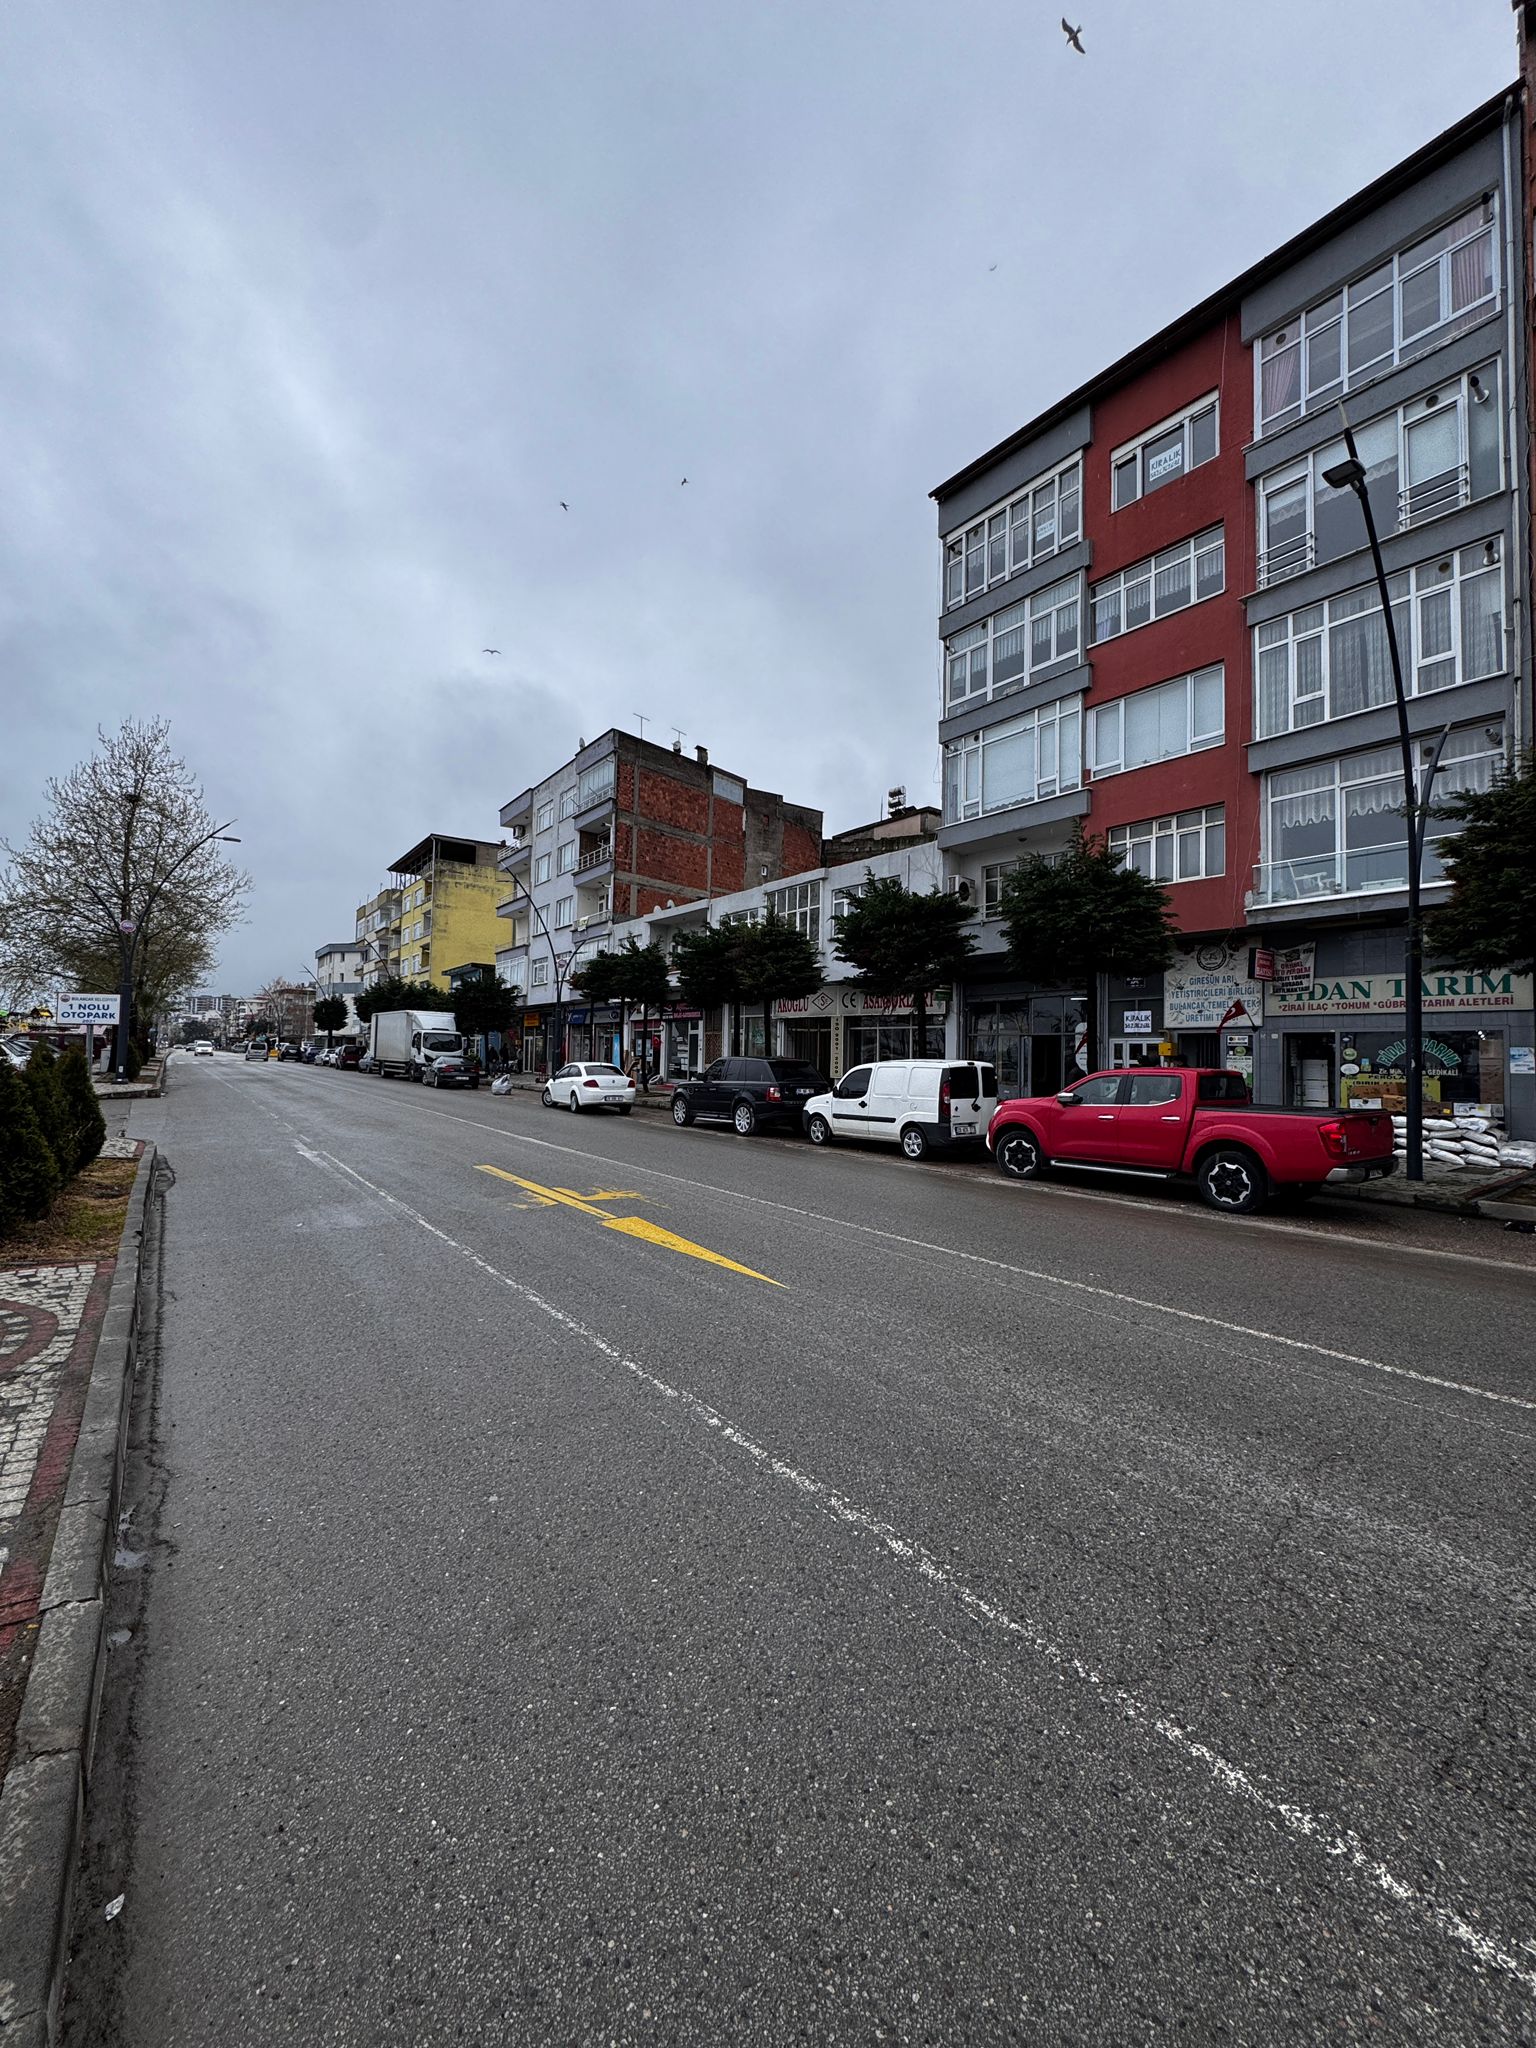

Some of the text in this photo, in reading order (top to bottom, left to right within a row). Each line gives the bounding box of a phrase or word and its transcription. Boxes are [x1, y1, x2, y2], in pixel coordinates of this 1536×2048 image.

[1279, 980, 1374, 1003] DAN
[78, 1003, 110, 1011] NOLU
[841, 992, 857, 1009] CE
[1207, 1001, 1230, 1009] TEMEL
[1373, 999, 1407, 1009] GÜBR
[1458, 995, 1514, 1007] ALETLERİ
[61, 1011, 116, 1020] OTOPARK
[1377, 1038, 1407, 1068] FİDA
